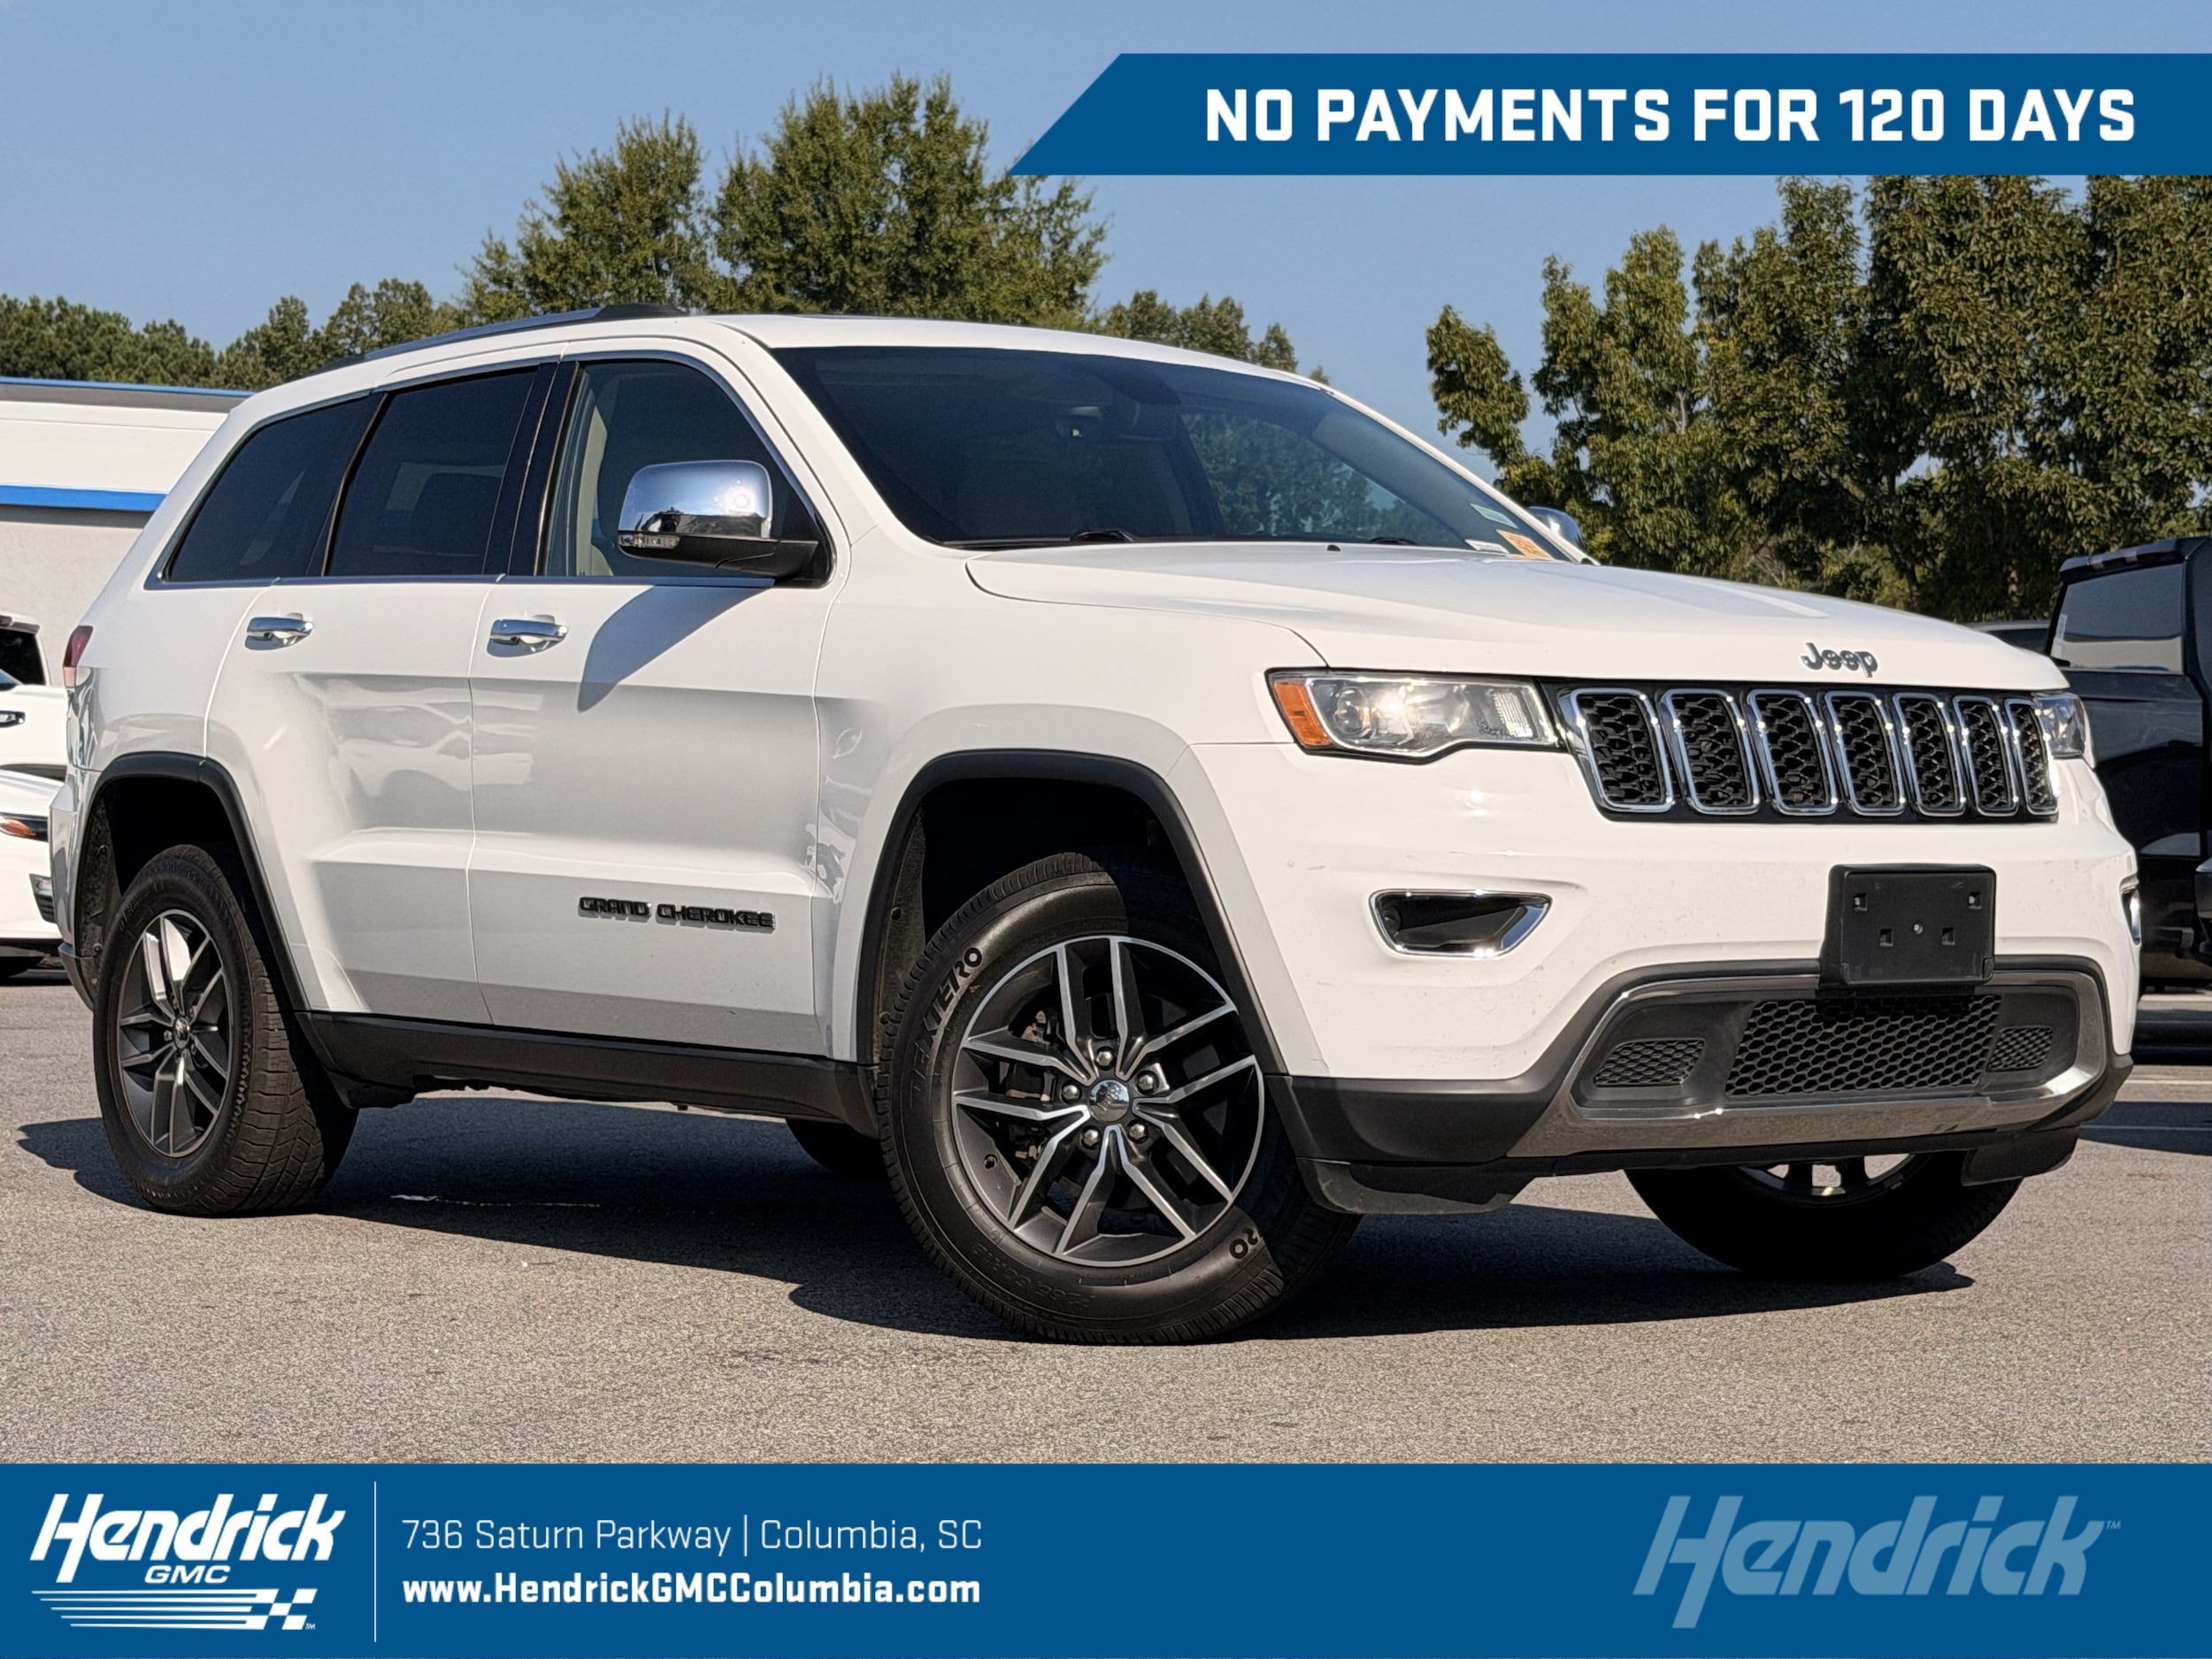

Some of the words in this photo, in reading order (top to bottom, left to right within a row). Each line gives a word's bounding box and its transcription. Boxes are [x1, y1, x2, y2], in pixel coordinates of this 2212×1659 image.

[1800, 641, 1878, 679] Jeep
[579, 896, 650, 918] GRAND
[657, 902, 775, 928] CHEROKEE
